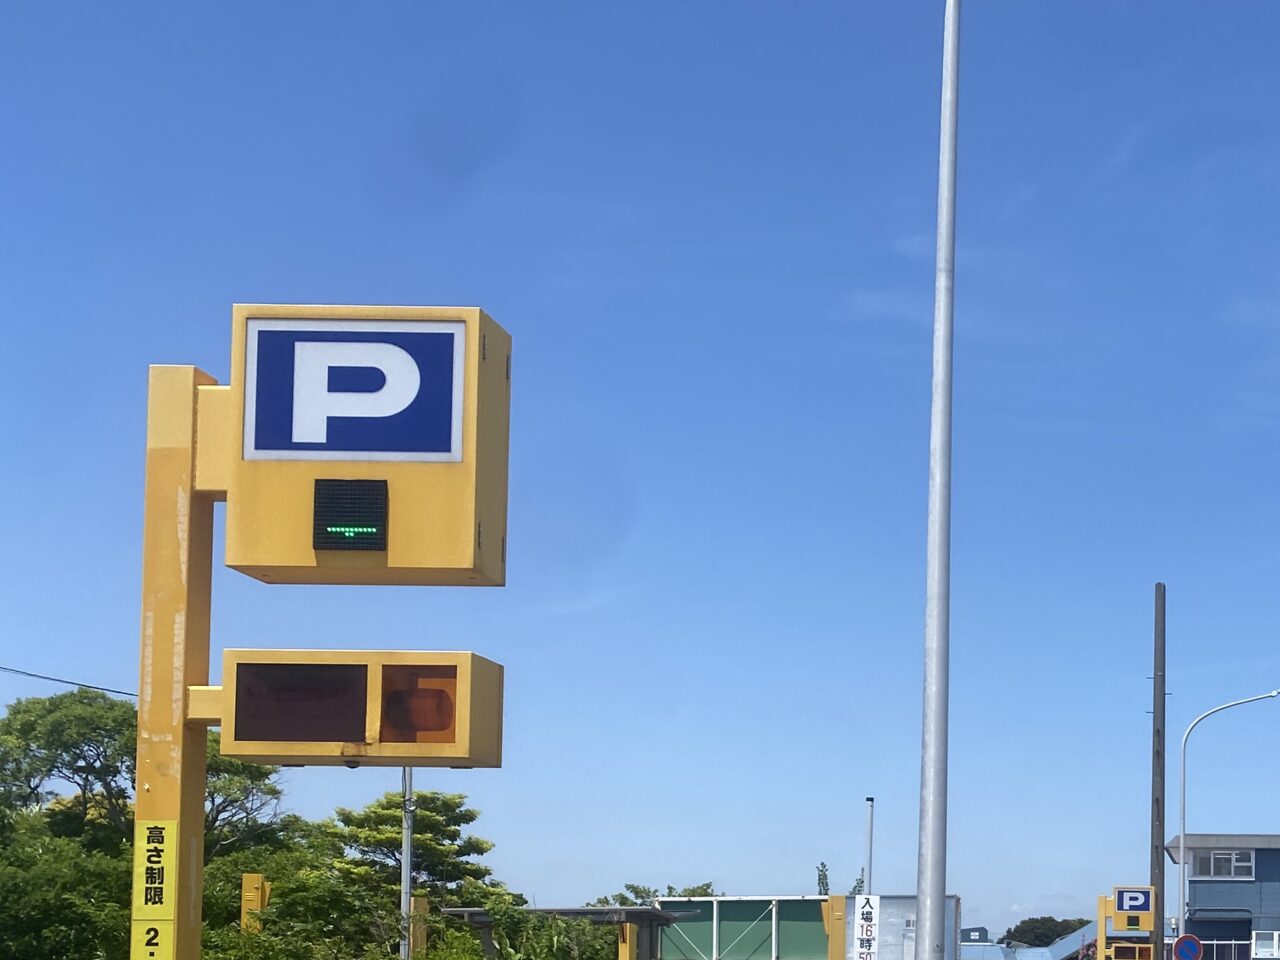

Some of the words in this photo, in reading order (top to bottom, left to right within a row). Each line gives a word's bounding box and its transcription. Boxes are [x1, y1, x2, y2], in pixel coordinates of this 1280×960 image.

[292, 341, 421, 444] P
[144, 826, 166, 906] 高さ制限
[1123, 891, 1145, 910] P
